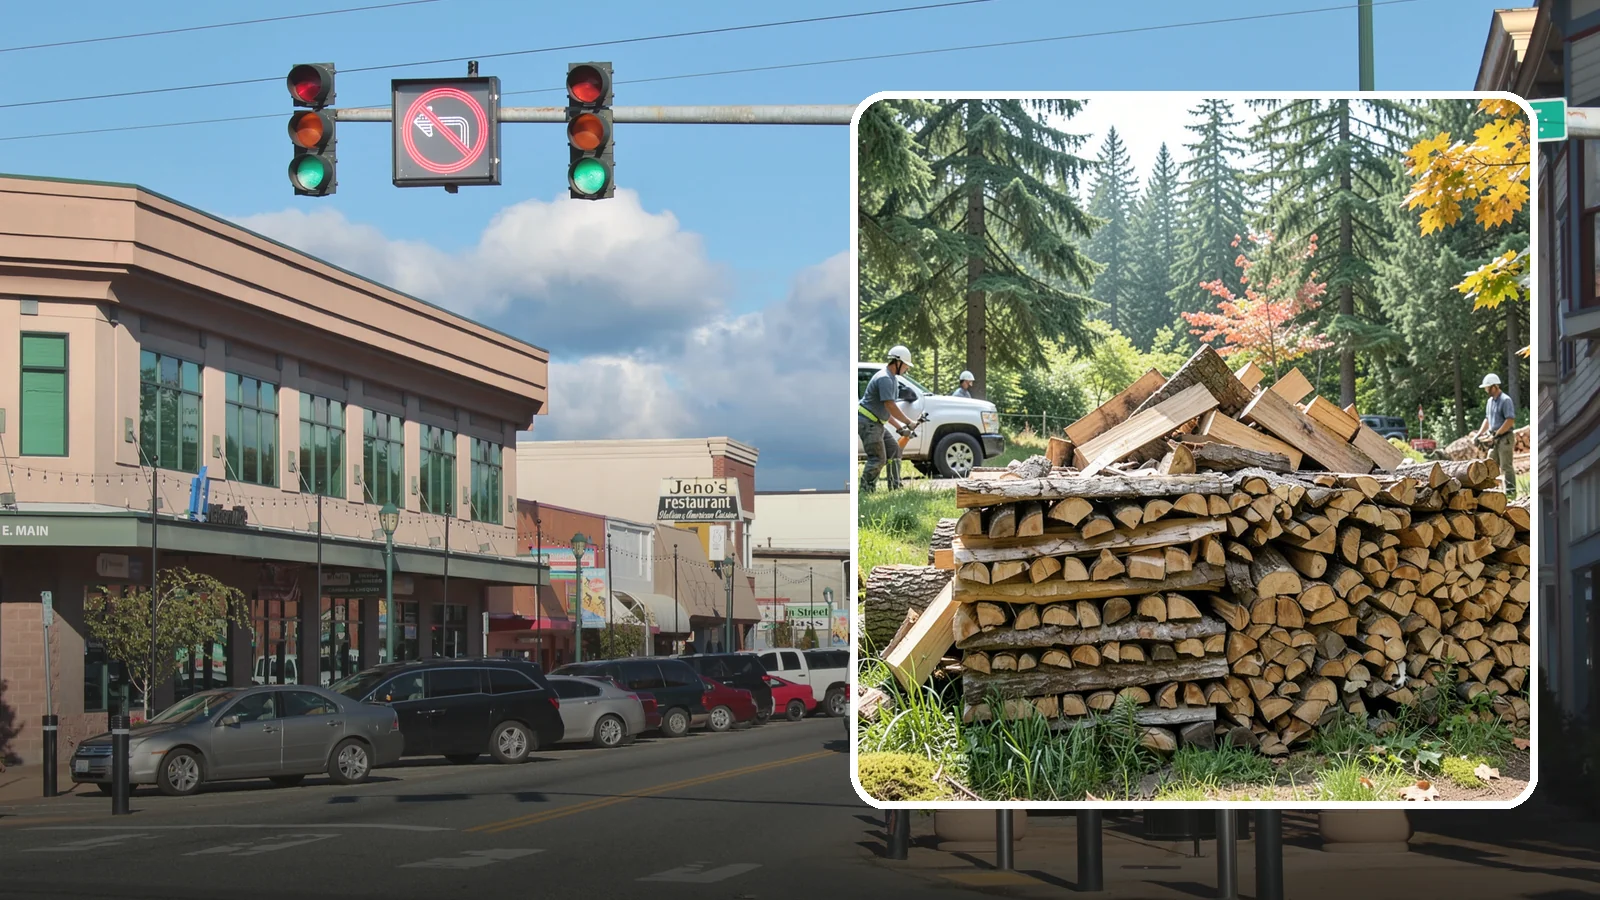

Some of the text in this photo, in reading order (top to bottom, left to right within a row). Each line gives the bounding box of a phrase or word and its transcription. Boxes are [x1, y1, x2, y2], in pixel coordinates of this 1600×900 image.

[670, 480, 726, 494] Jeno's
[665, 496, 731, 509] restaurant
[658, 510, 681, 519] Italian
[686, 510, 714, 519] American
[715, 510, 738, 519] Cuisine
[2, 525, 49, 536] E. MAIN
[797, 608, 828, 616] Street
